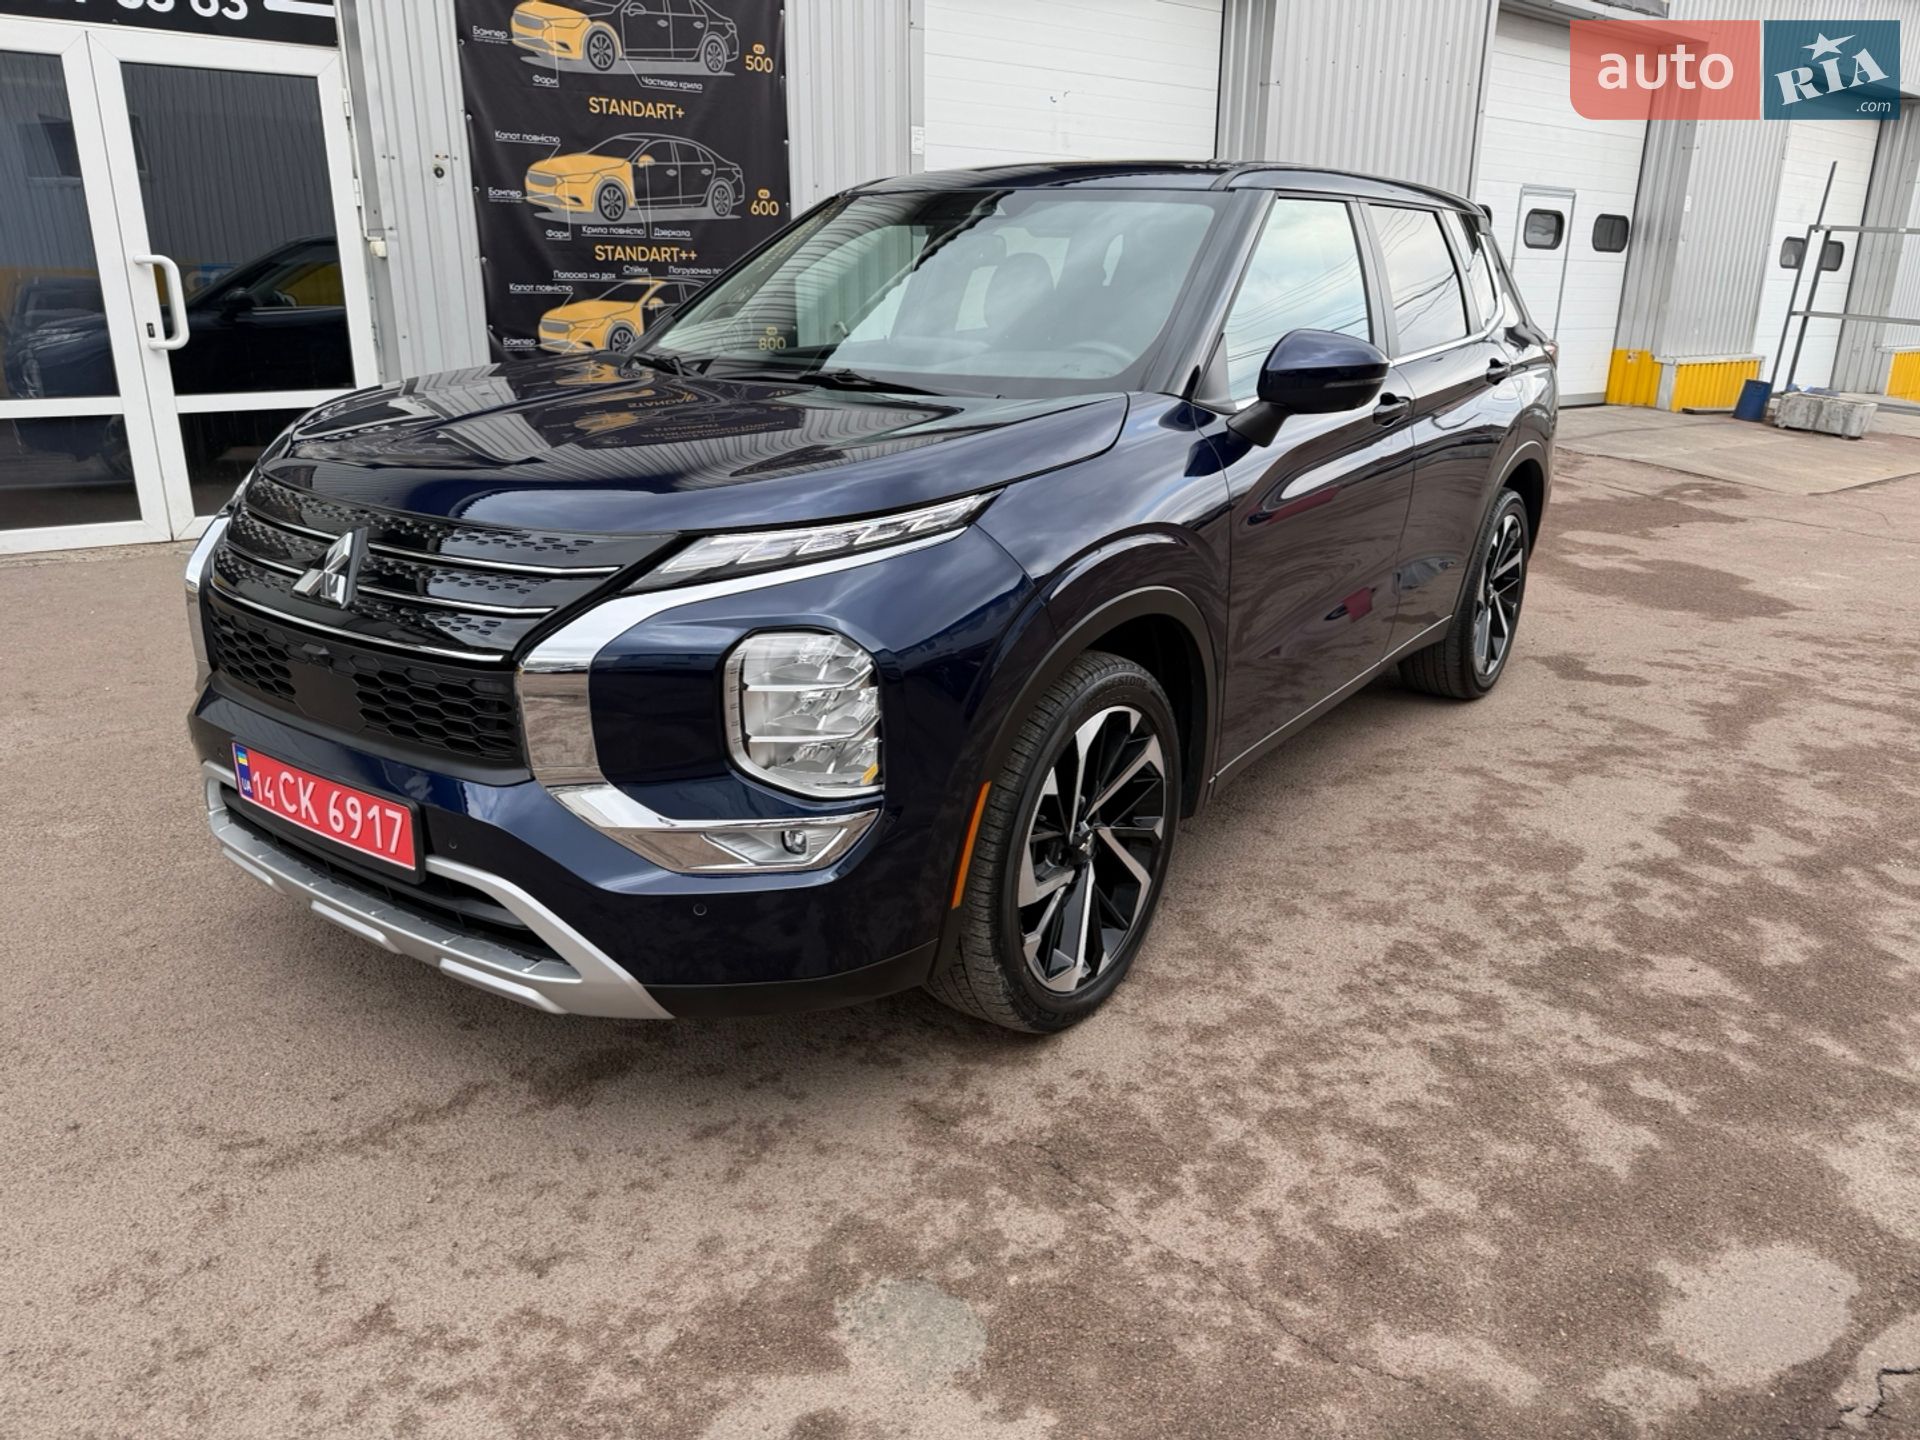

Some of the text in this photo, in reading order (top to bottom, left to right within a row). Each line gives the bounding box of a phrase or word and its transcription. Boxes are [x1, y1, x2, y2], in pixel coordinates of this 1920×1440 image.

[472, 25, 508, 39] Бампер
[744, 55, 774, 73] 500
[588, 96, 685, 120] STANDART+
[494, 130, 521, 140] Капот
[487, 186, 522, 198] Бампер
[750, 200, 780, 216] 600
[594, 244, 697, 262] STANDART++
[508, 282, 535, 293] Капот
[502, 337, 536, 347] Бампер
[758, 337, 787, 351] 800
[328, 790, 403, 854] 6917
